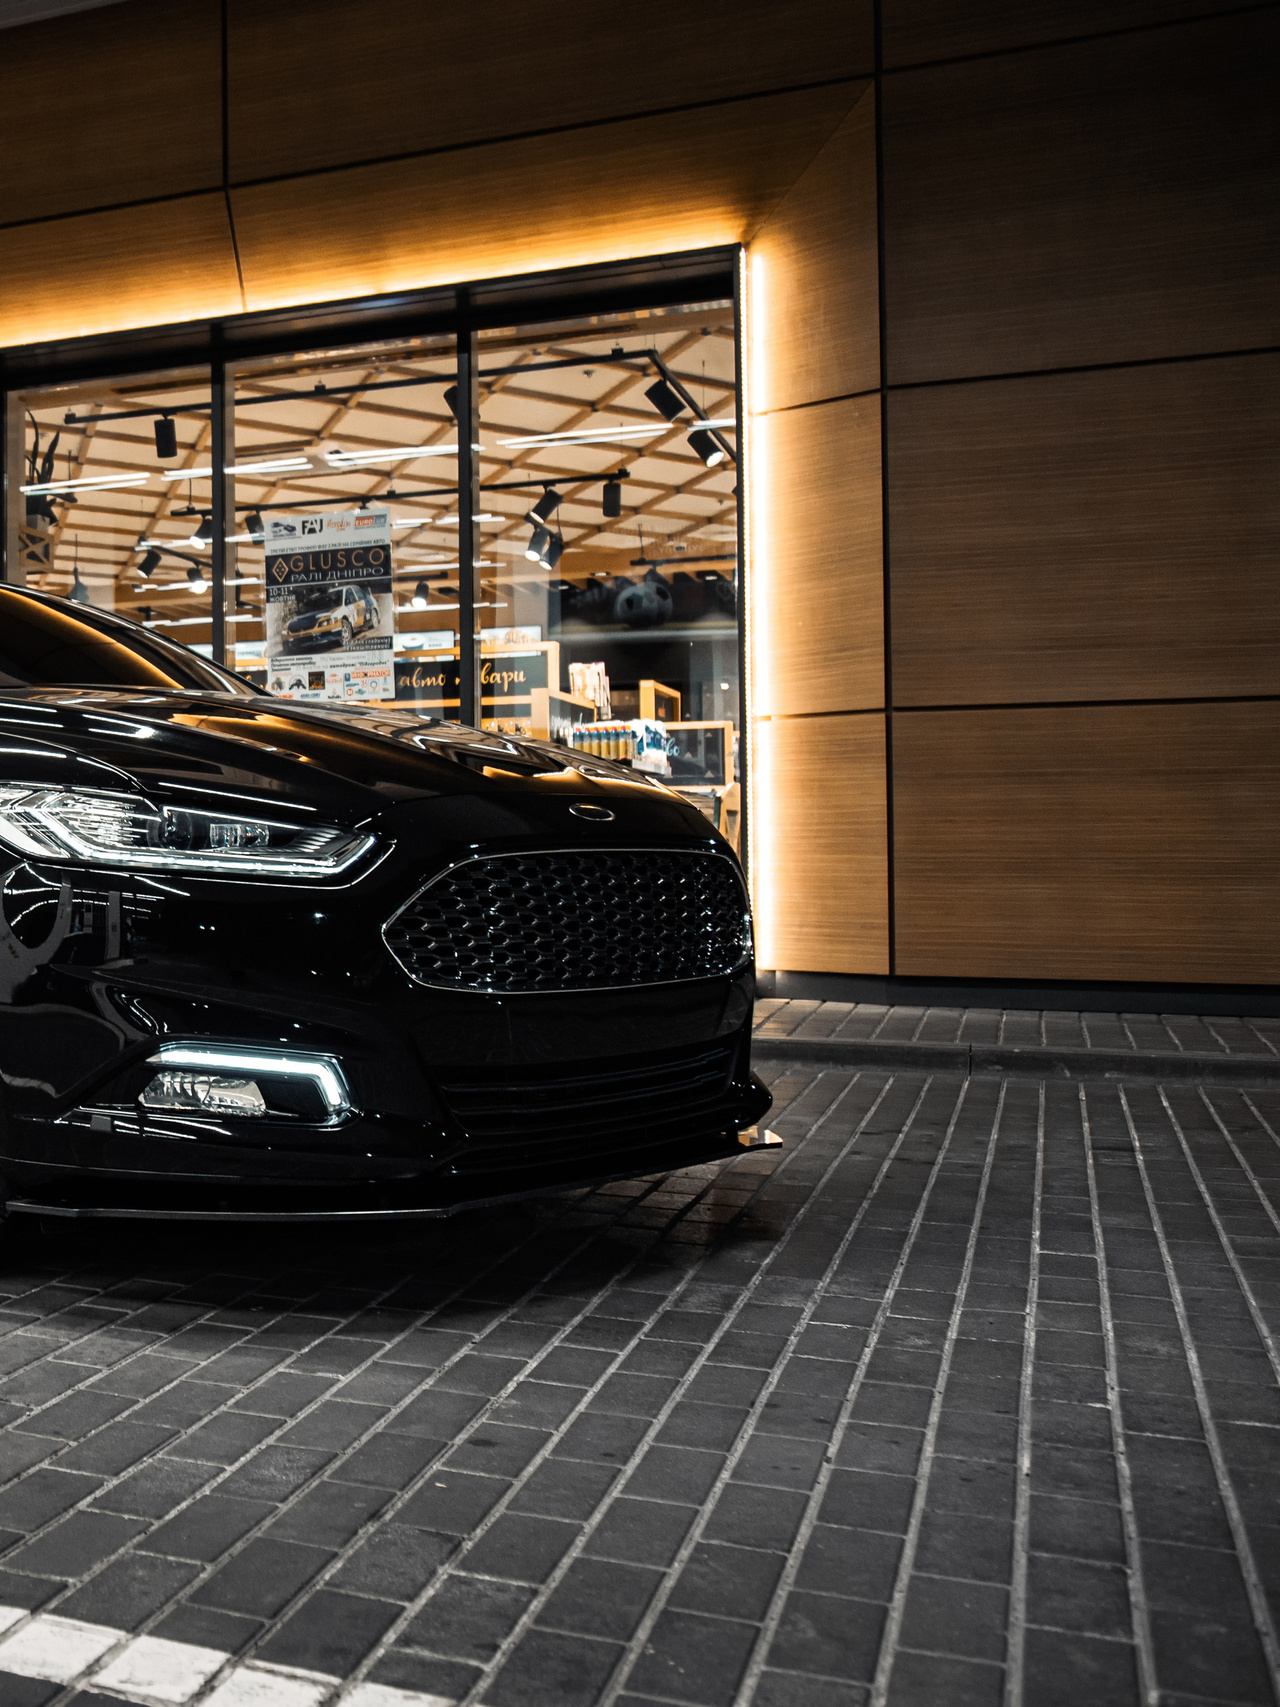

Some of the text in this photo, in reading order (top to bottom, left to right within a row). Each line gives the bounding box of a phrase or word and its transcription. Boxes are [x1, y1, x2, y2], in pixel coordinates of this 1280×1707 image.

[290, 547, 384, 572] GLUSCO
[291, 567, 384, 583] РАЛІ ДНІПРО
[270, 586, 288, 596] 10-11
[397, 666, 446, 688] авто
